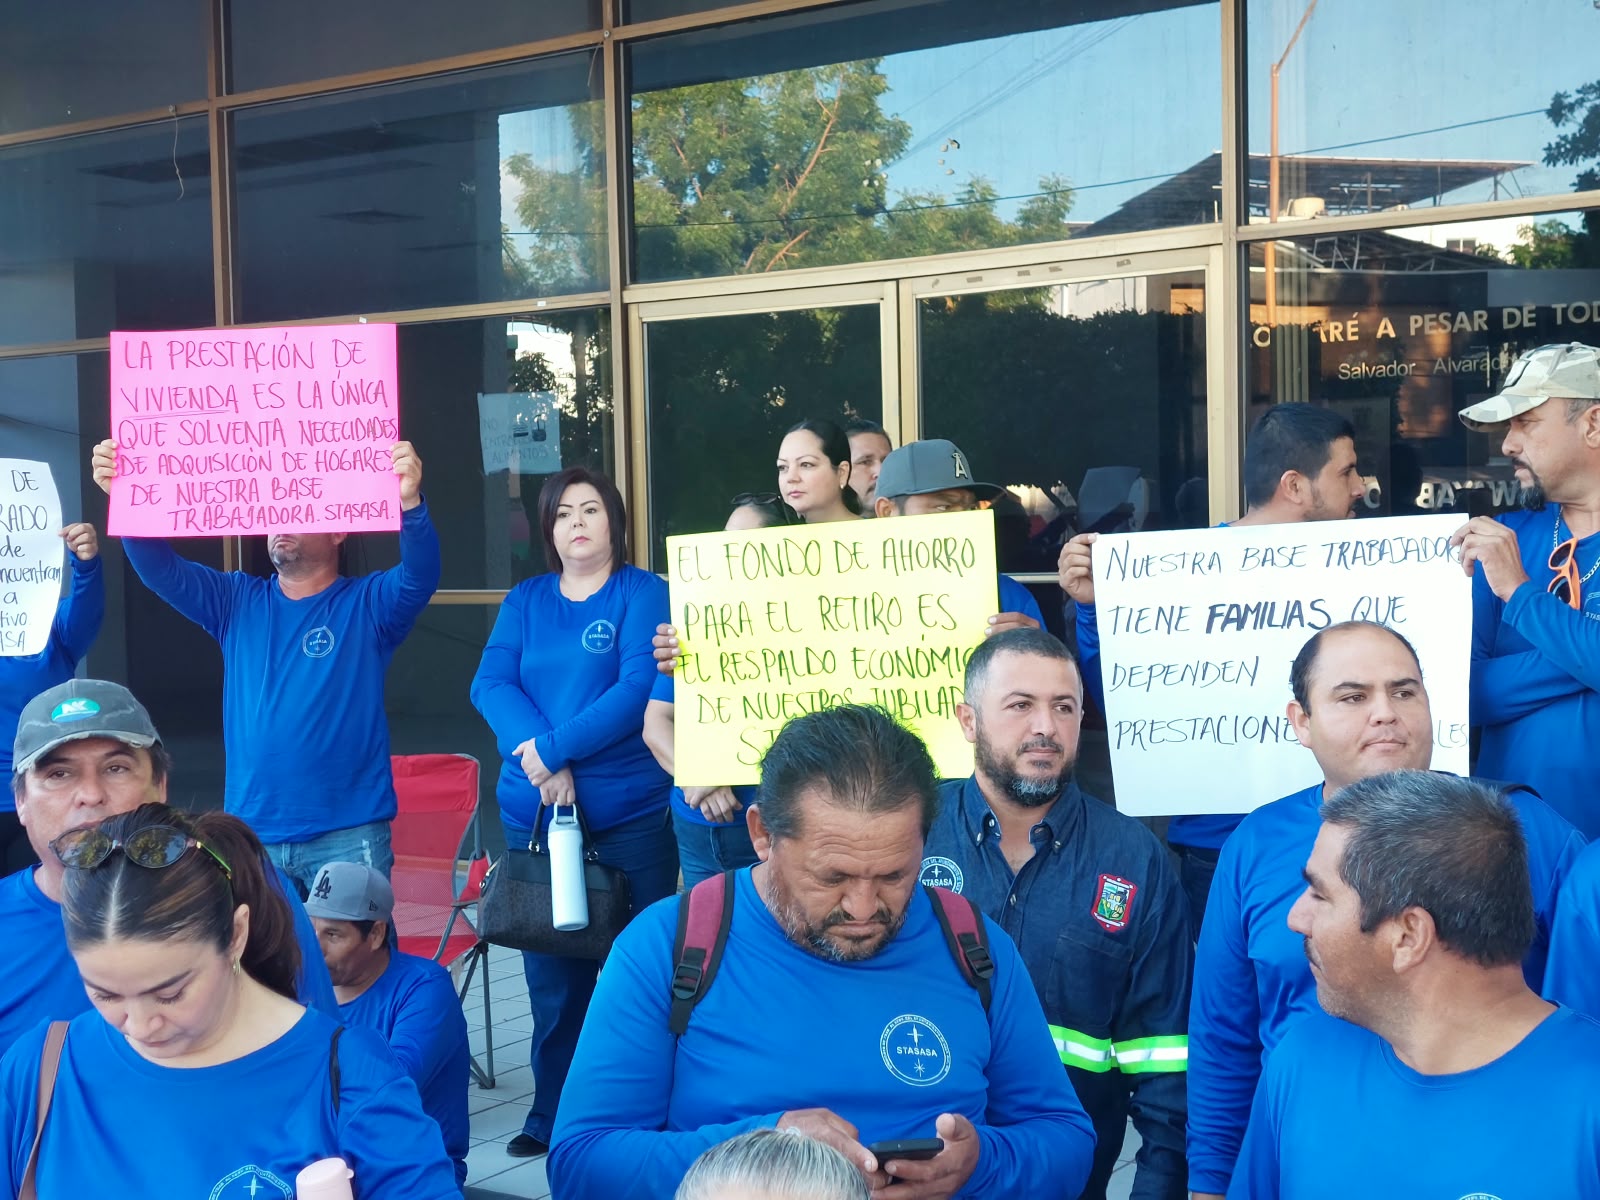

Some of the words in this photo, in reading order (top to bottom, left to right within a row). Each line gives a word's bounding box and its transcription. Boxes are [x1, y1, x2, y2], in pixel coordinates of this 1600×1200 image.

[1376, 317, 1396, 339] A
[1409, 310, 1488, 337] PESAR
[1502, 304, 1537, 329] DE
[124, 340, 152, 370] LA
[167, 331, 315, 373] PRESTACIÓN
[332, 338, 367, 368] DE
[1338, 359, 1416, 381] Salvador
[120, 384, 239, 414] VIVIENDA
[253, 381, 285, 410] ES
[297, 380, 323, 410] LA
[331, 370, 388, 408] ÚNICA
[118, 419, 168, 450] QUE
[177, 417, 287, 448] SOLVENTA
[120, 456, 148, 477] DE
[158, 447, 272, 477] ADQUISICIÓN
[281, 451, 307, 471] DE
[315, 446, 394, 473] HOGARES
[11, 469, 39, 493] DE
[130, 482, 162, 507] DE
[176, 477, 260, 506] NUESTRA
[271, 477, 323, 501] BASE
[167, 503, 321, 533] TRABAJADORA.
[324, 499, 395, 524] STASASA.
[678, 546, 712, 583] EL
[723, 538, 822, 581] FONDO
[834, 540, 869, 574] DE
[882, 537, 976, 577] AHORRO
[1106, 540, 1222, 581] NUESTRA
[1239, 545, 1308, 572] BASE
[4, 591, 18, 605] a
[1107, 605, 1192, 635] TIENE
[1205, 597, 1332, 634] FAMILIAS
[1350, 595, 1408, 627] QUE
[683, 600, 753, 647] PARA
[766, 600, 803, 633] EL
[818, 591, 902, 635] RETIRO
[918, 593, 957, 631] ES
[679, 652, 711, 685] EL
[719, 646, 837, 686] RESPALDO
[1109, 656, 1260, 692] DEPENDEN
[697, 693, 732, 724] DE
[896, 1046, 938, 1059] STASASA
